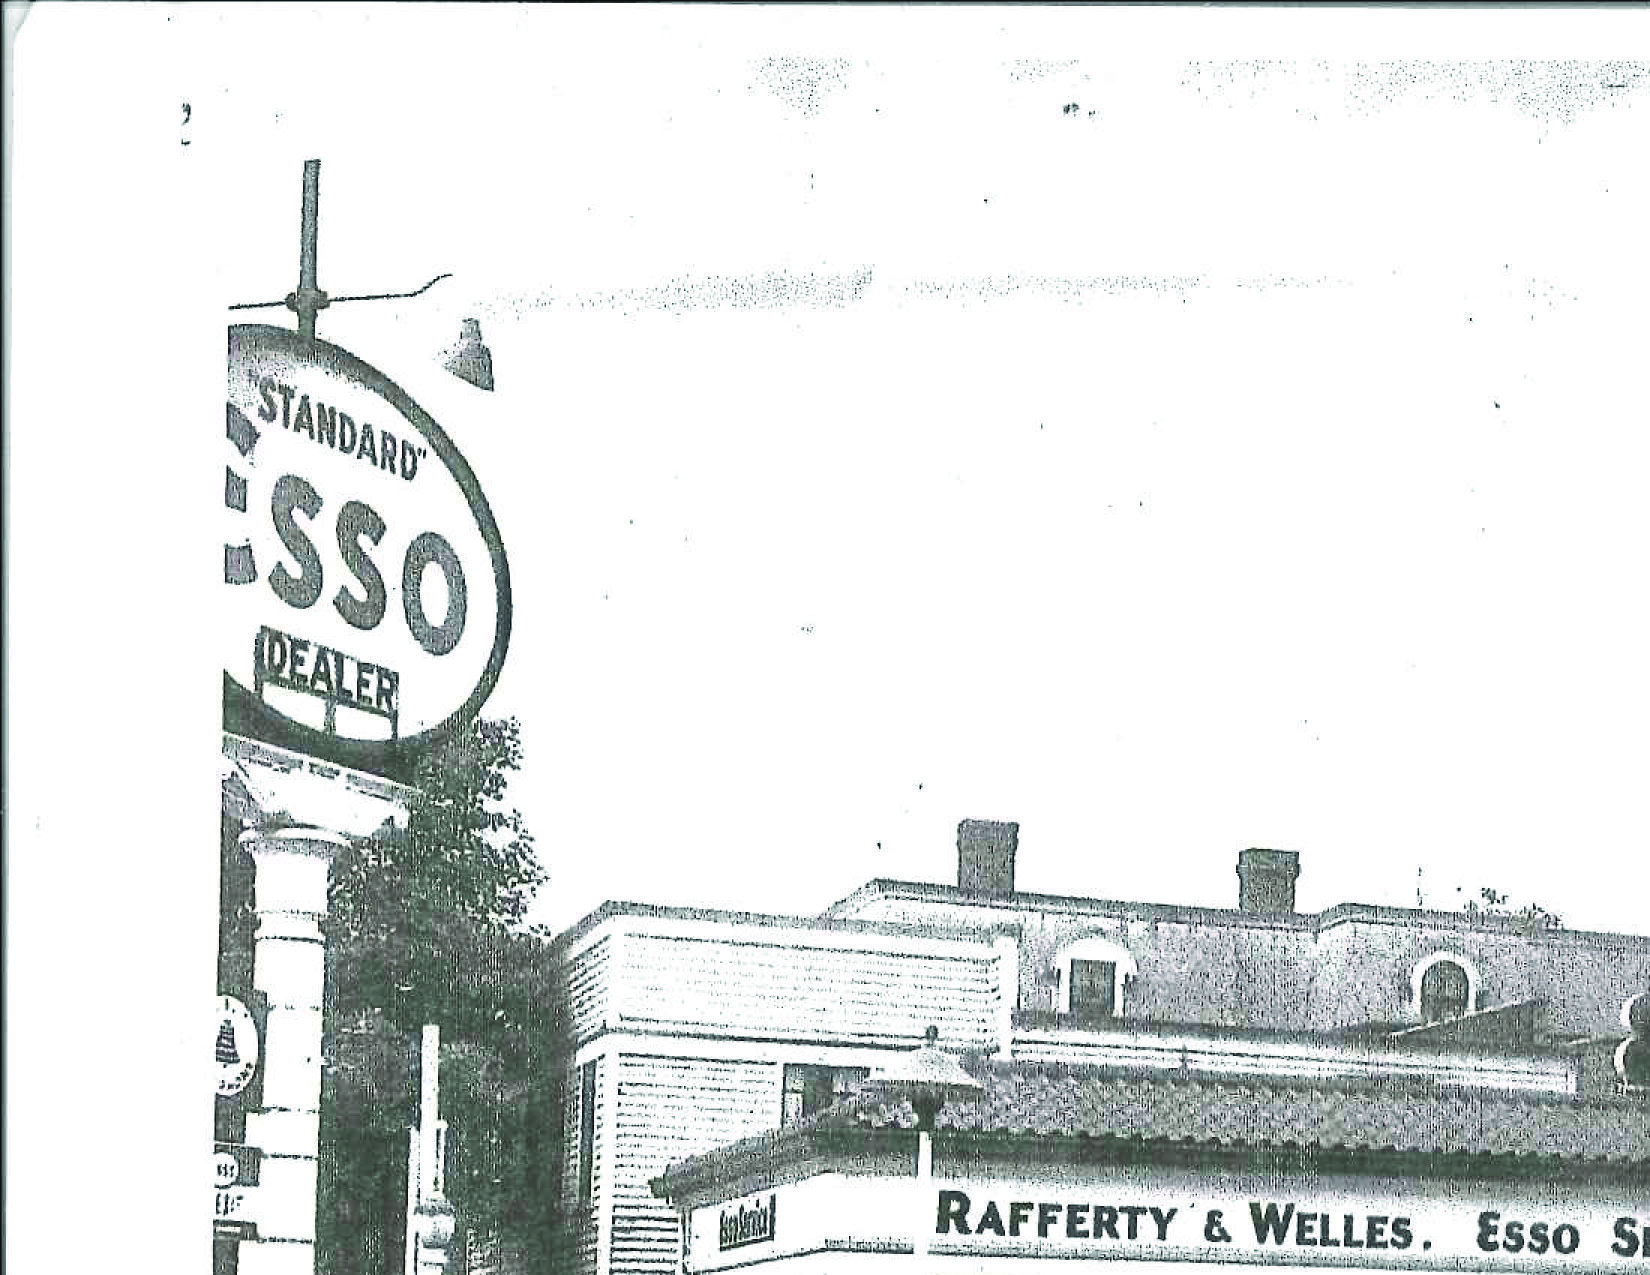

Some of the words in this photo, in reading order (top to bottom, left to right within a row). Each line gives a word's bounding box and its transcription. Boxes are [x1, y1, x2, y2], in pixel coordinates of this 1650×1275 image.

[266, 629, 399, 712] DEALER
[936, 1190, 1178, 1241] RAFFERTY
[1203, 1209, 1232, 1243] &
[1249, 1202, 1432, 1250] WELLES.
